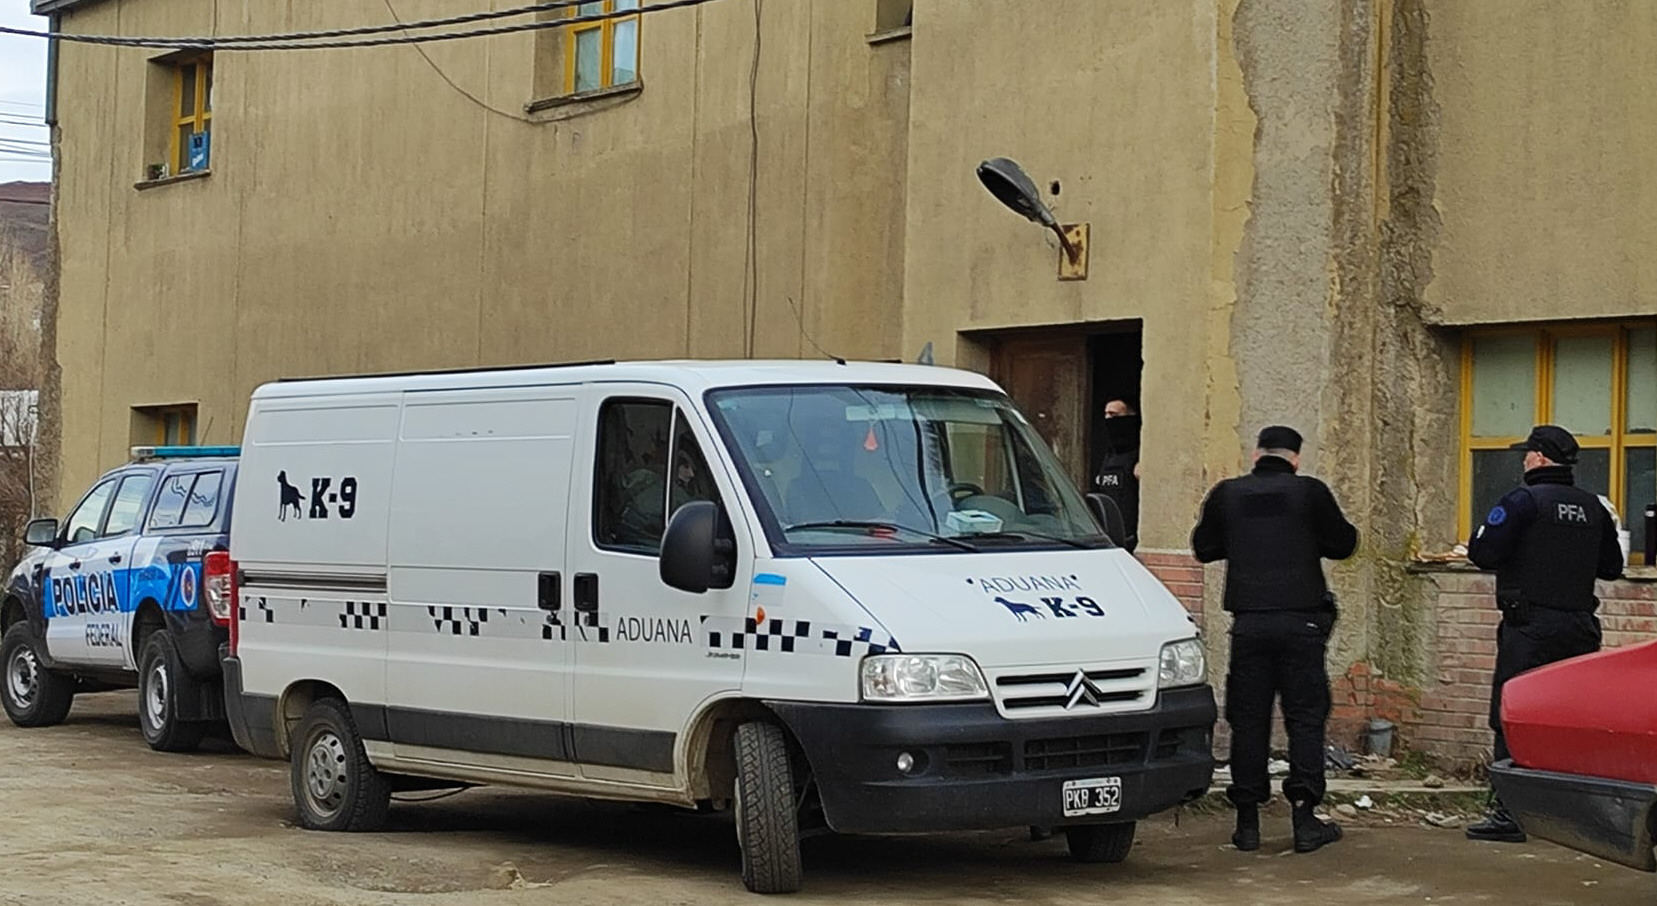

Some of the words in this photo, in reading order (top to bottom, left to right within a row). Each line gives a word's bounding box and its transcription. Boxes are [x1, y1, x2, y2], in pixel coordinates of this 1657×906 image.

[309, 477, 358, 519] K-9
[1557, 503, 1587, 522] PFA
[979, 575, 1083, 594] ADUANA
[1039, 596, 1106, 618] K-9
[86, 622, 123, 648] FEDERAL
[616, 616, 693, 644] ADUANA
[1065, 788, 1089, 809] PKB
[1095, 786, 1119, 807] 352
